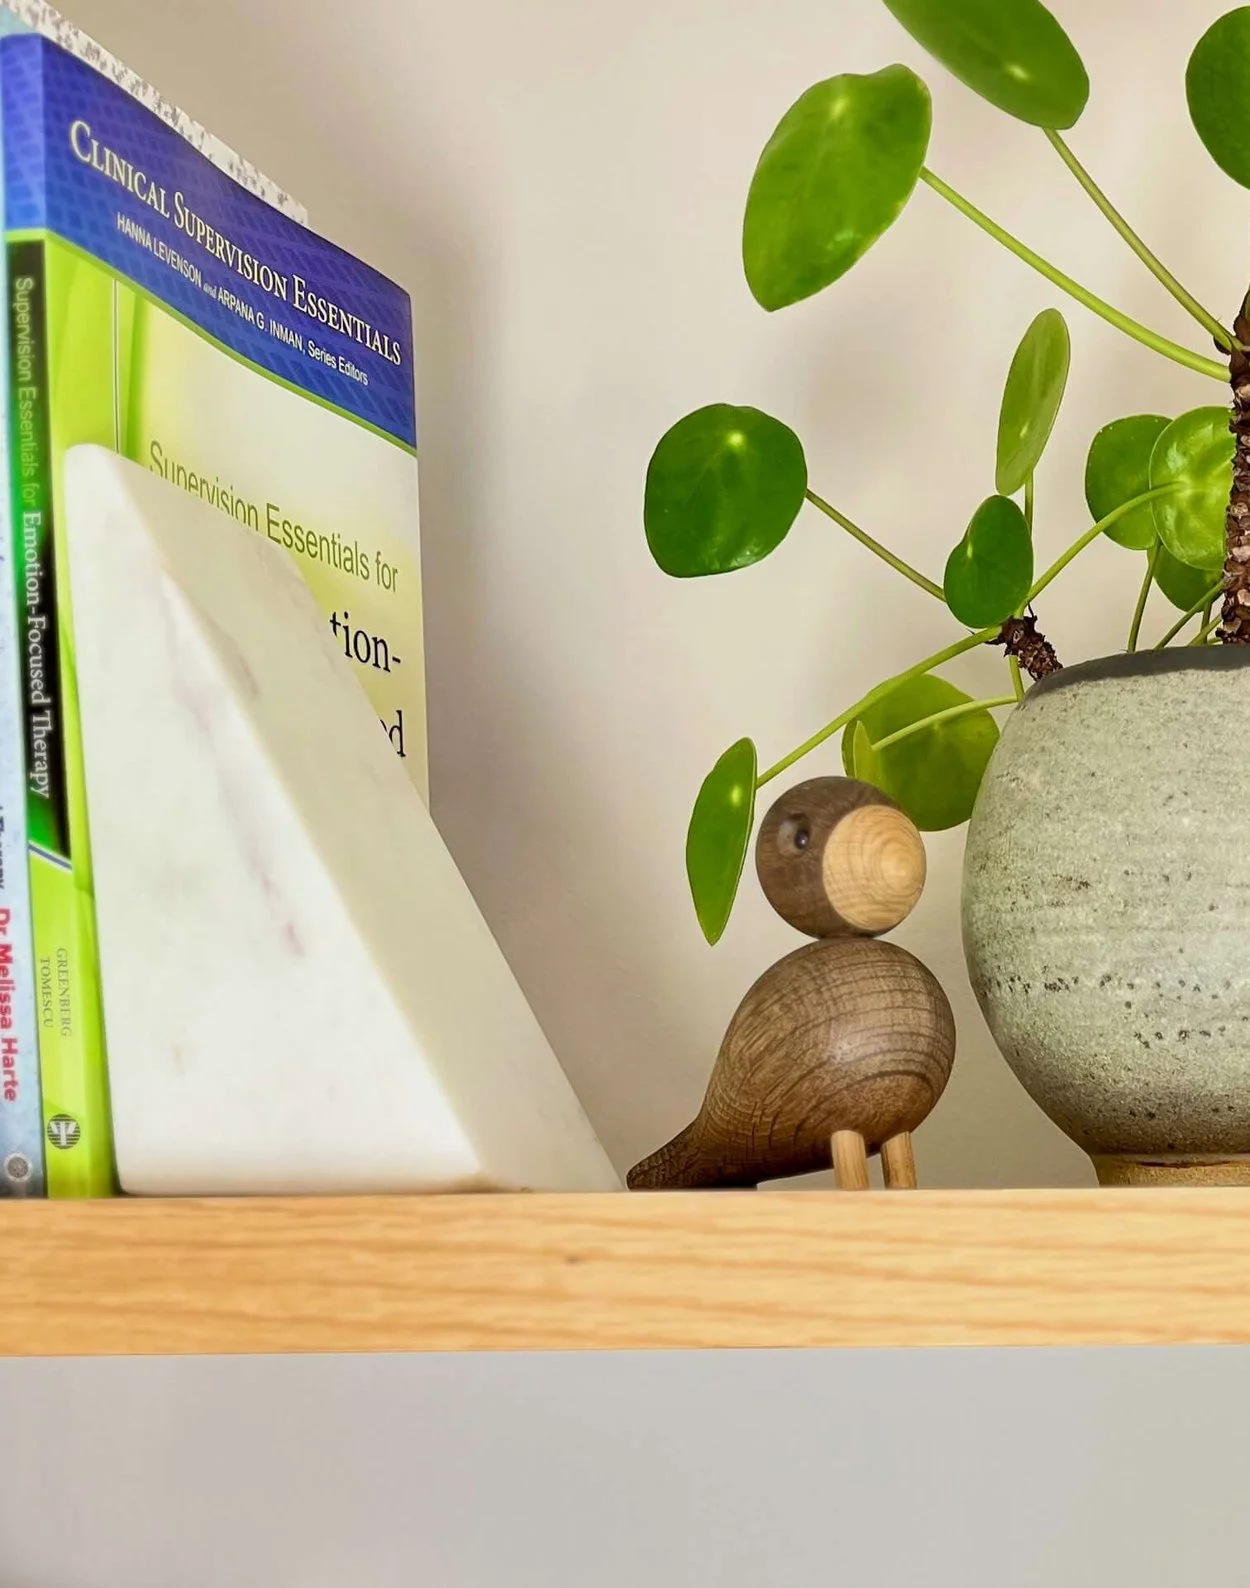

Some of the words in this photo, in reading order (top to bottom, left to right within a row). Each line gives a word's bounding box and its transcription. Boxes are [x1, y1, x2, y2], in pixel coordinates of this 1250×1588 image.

[12, 276, 35, 381] Supervision
[117, 212, 152, 251] HANNA
[153, 237, 202, 288] LEVENSON
[203, 280, 217, 299] and
[217, 287, 255, 325] ARPANA
[256, 312, 267, 332] G.
[270, 320, 306, 354] INMAN,
[307, 340, 337, 369] Series
[338, 356, 369, 386] Editors
[18, 387, 39, 477] Essentials
[22, 483, 40, 506] for
[266, 502, 370, 581] Essentials
[375, 551, 398, 593] for
[22, 511, 51, 705] Emotion-Focused
[30, 710, 53, 799] Therapy
[0, 943, 16, 1030] Melissa
[39, 957, 54, 1028] TOMESCU
[56, 948, 72, 1037] GREENBERG
[1, 1037, 19, 1102] Harte
